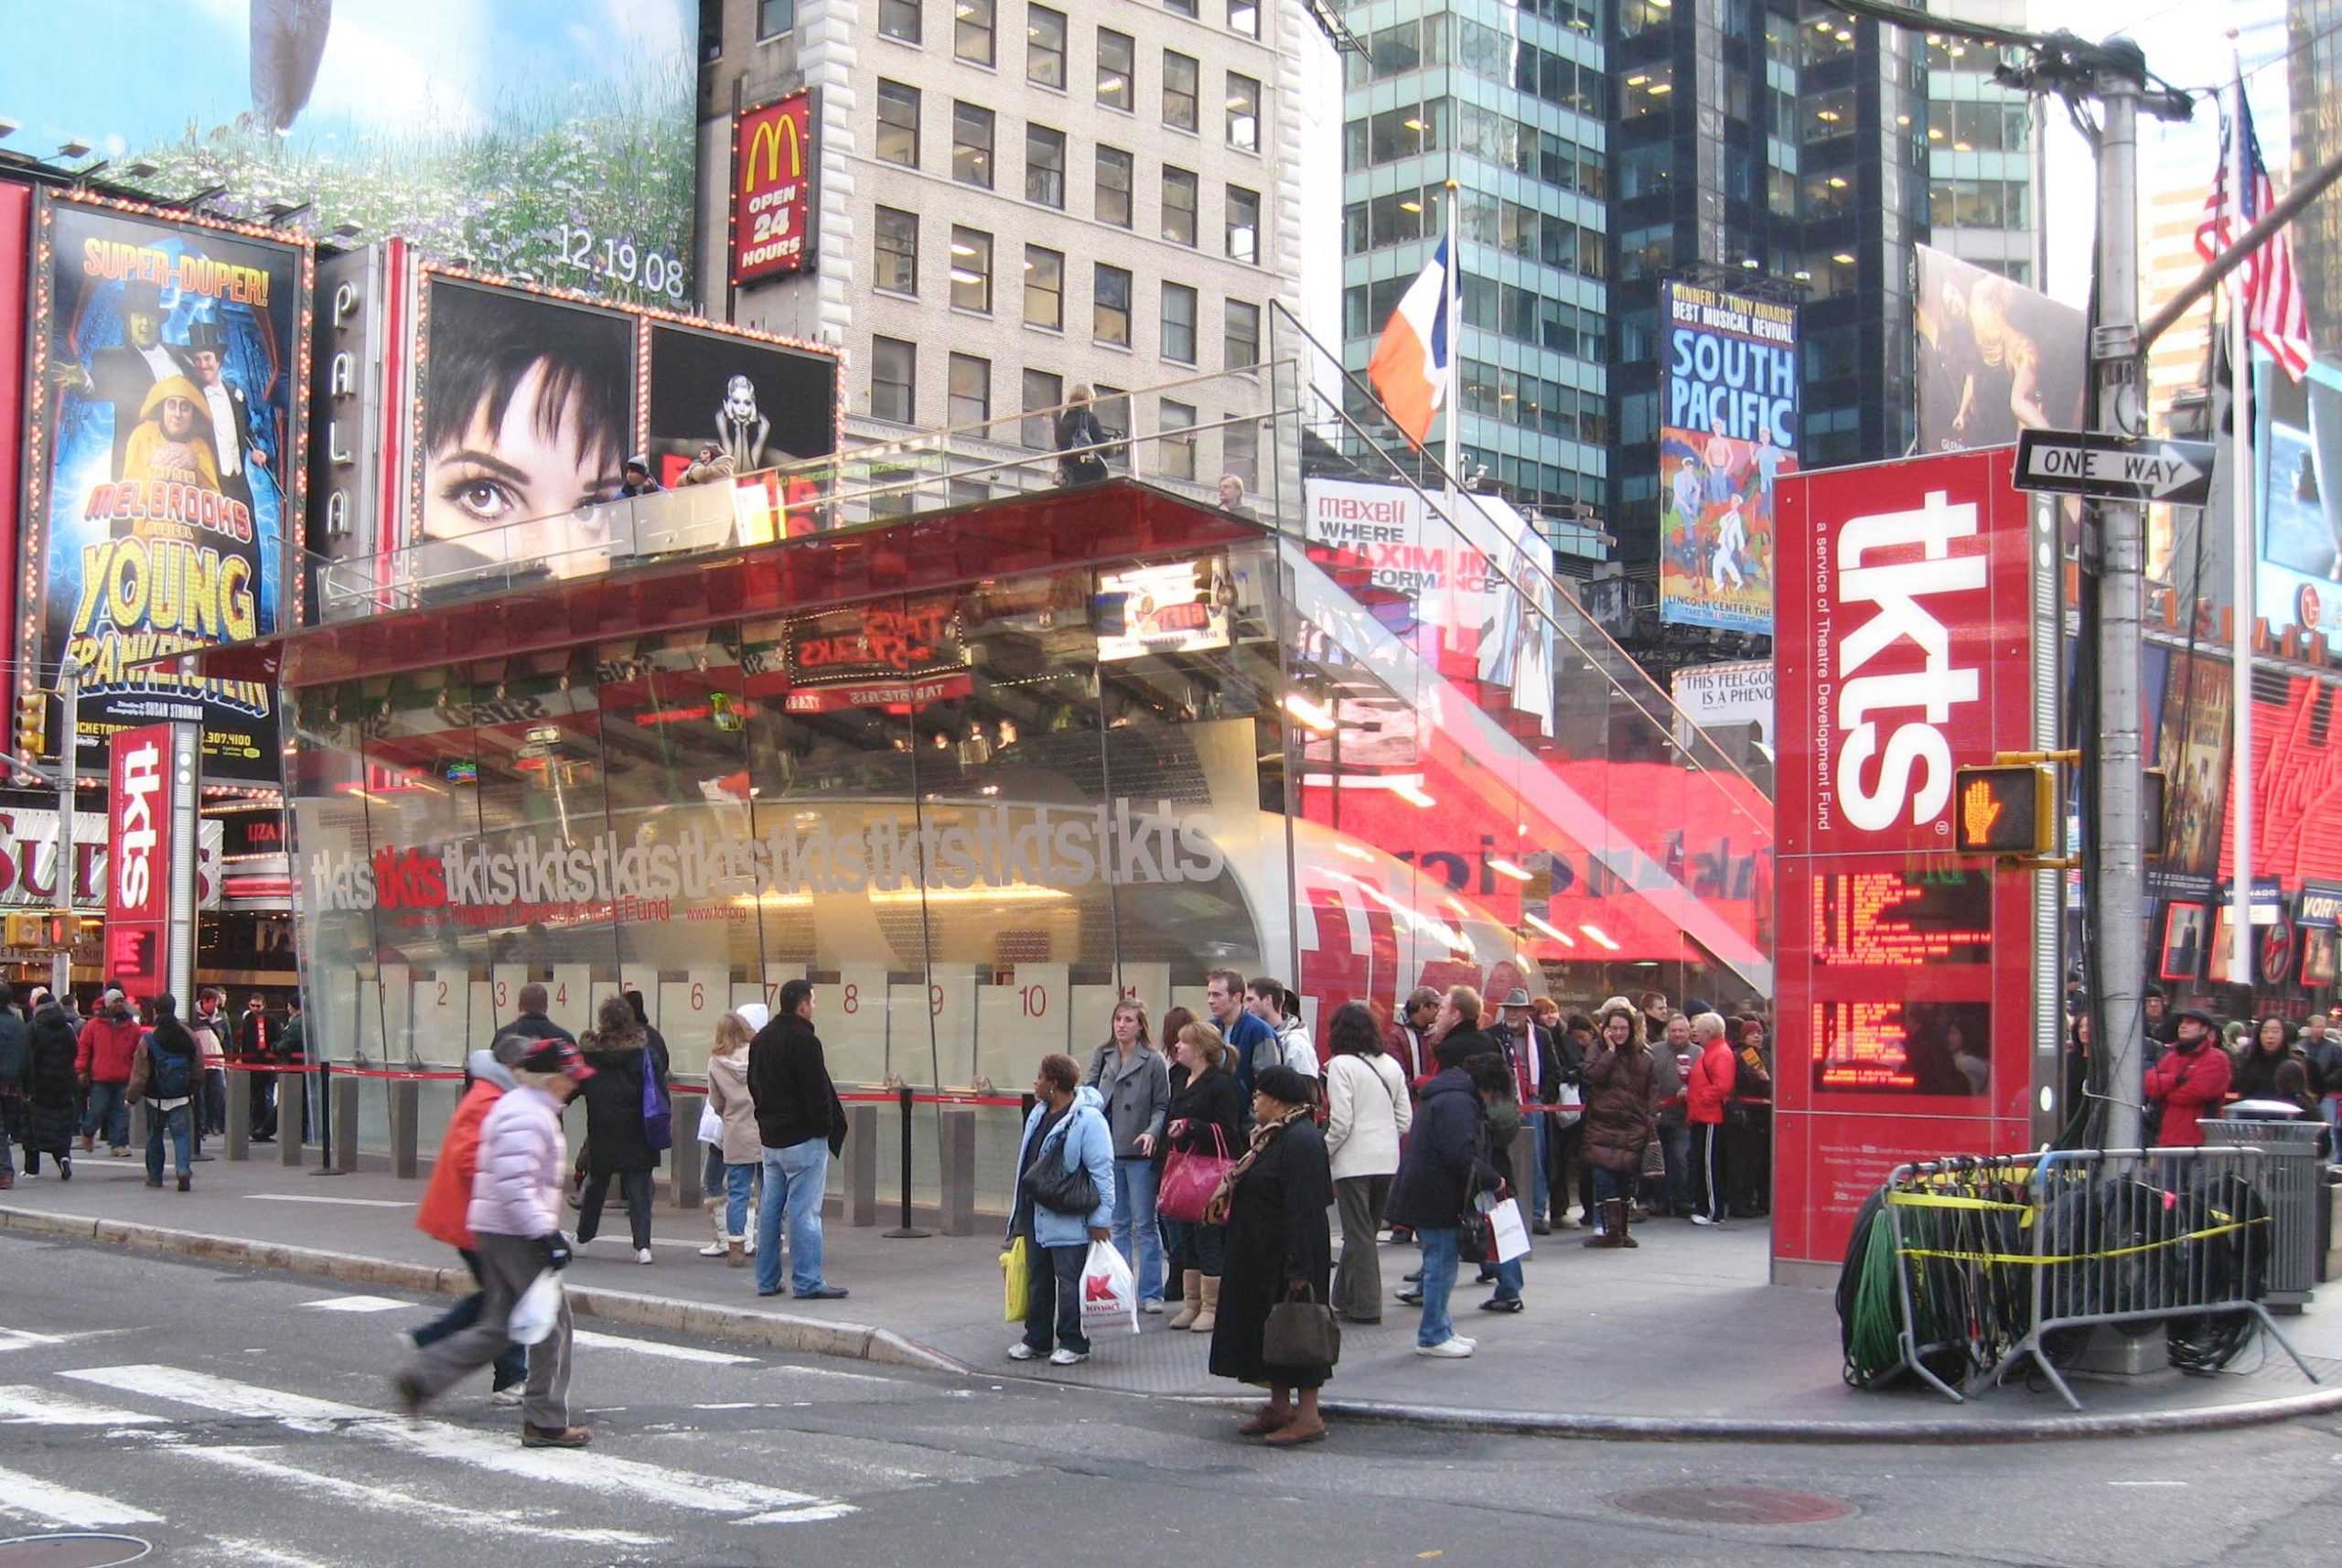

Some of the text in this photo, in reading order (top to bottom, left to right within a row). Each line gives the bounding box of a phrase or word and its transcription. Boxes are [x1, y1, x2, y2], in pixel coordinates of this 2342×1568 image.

[748, 185, 796, 213] OPEN
[753, 208, 790, 243] 24
[558, 224, 684, 298] 12.19.08
[742, 235, 800, 267] HOURS
[83, 237, 269, 307] SUPER-DUPER!
[1672, 283, 1793, 325] WINNER! 7 TONY AWARDS
[1672, 300, 1700, 323] BEST
[1703, 307, 1749, 334] MUSICAL
[1753, 318, 1794, 344] REVIVAL
[1671, 328, 1794, 400] SOUTH
[1671, 376, 1793, 448] PACIFIC
[2044, 449, 2184, 483] ONE WAY
[85, 481, 252, 543] MEL BROOKS
[1318, 497, 1405, 524] maxell
[1318, 521, 1404, 543] WHERE
[1816, 537, 1831, 593] service
[71, 536, 257, 639] YOUNG
[1713, 598, 1751, 615] CENTER
[1816, 598, 1831, 612] of
[1816, 618, 1831, 678] Theatre
[1837, 490, 1986, 832] tkts
[1703, 687, 1774, 705] IS A PHENO
[1816, 684, 1831, 786] Development
[122, 742, 160, 908] tkts
[1816, 791, 1831, 830] Fund
[625, 894, 670, 923] Fund
[437, 981, 448, 1006] 2
[496, 981, 507, 1007] 3
[555, 982, 568, 1007] 4
[691, 982, 704, 1011] 6
[843, 983, 858, 1014] 8
[1018, 985, 1047, 1016] 10
